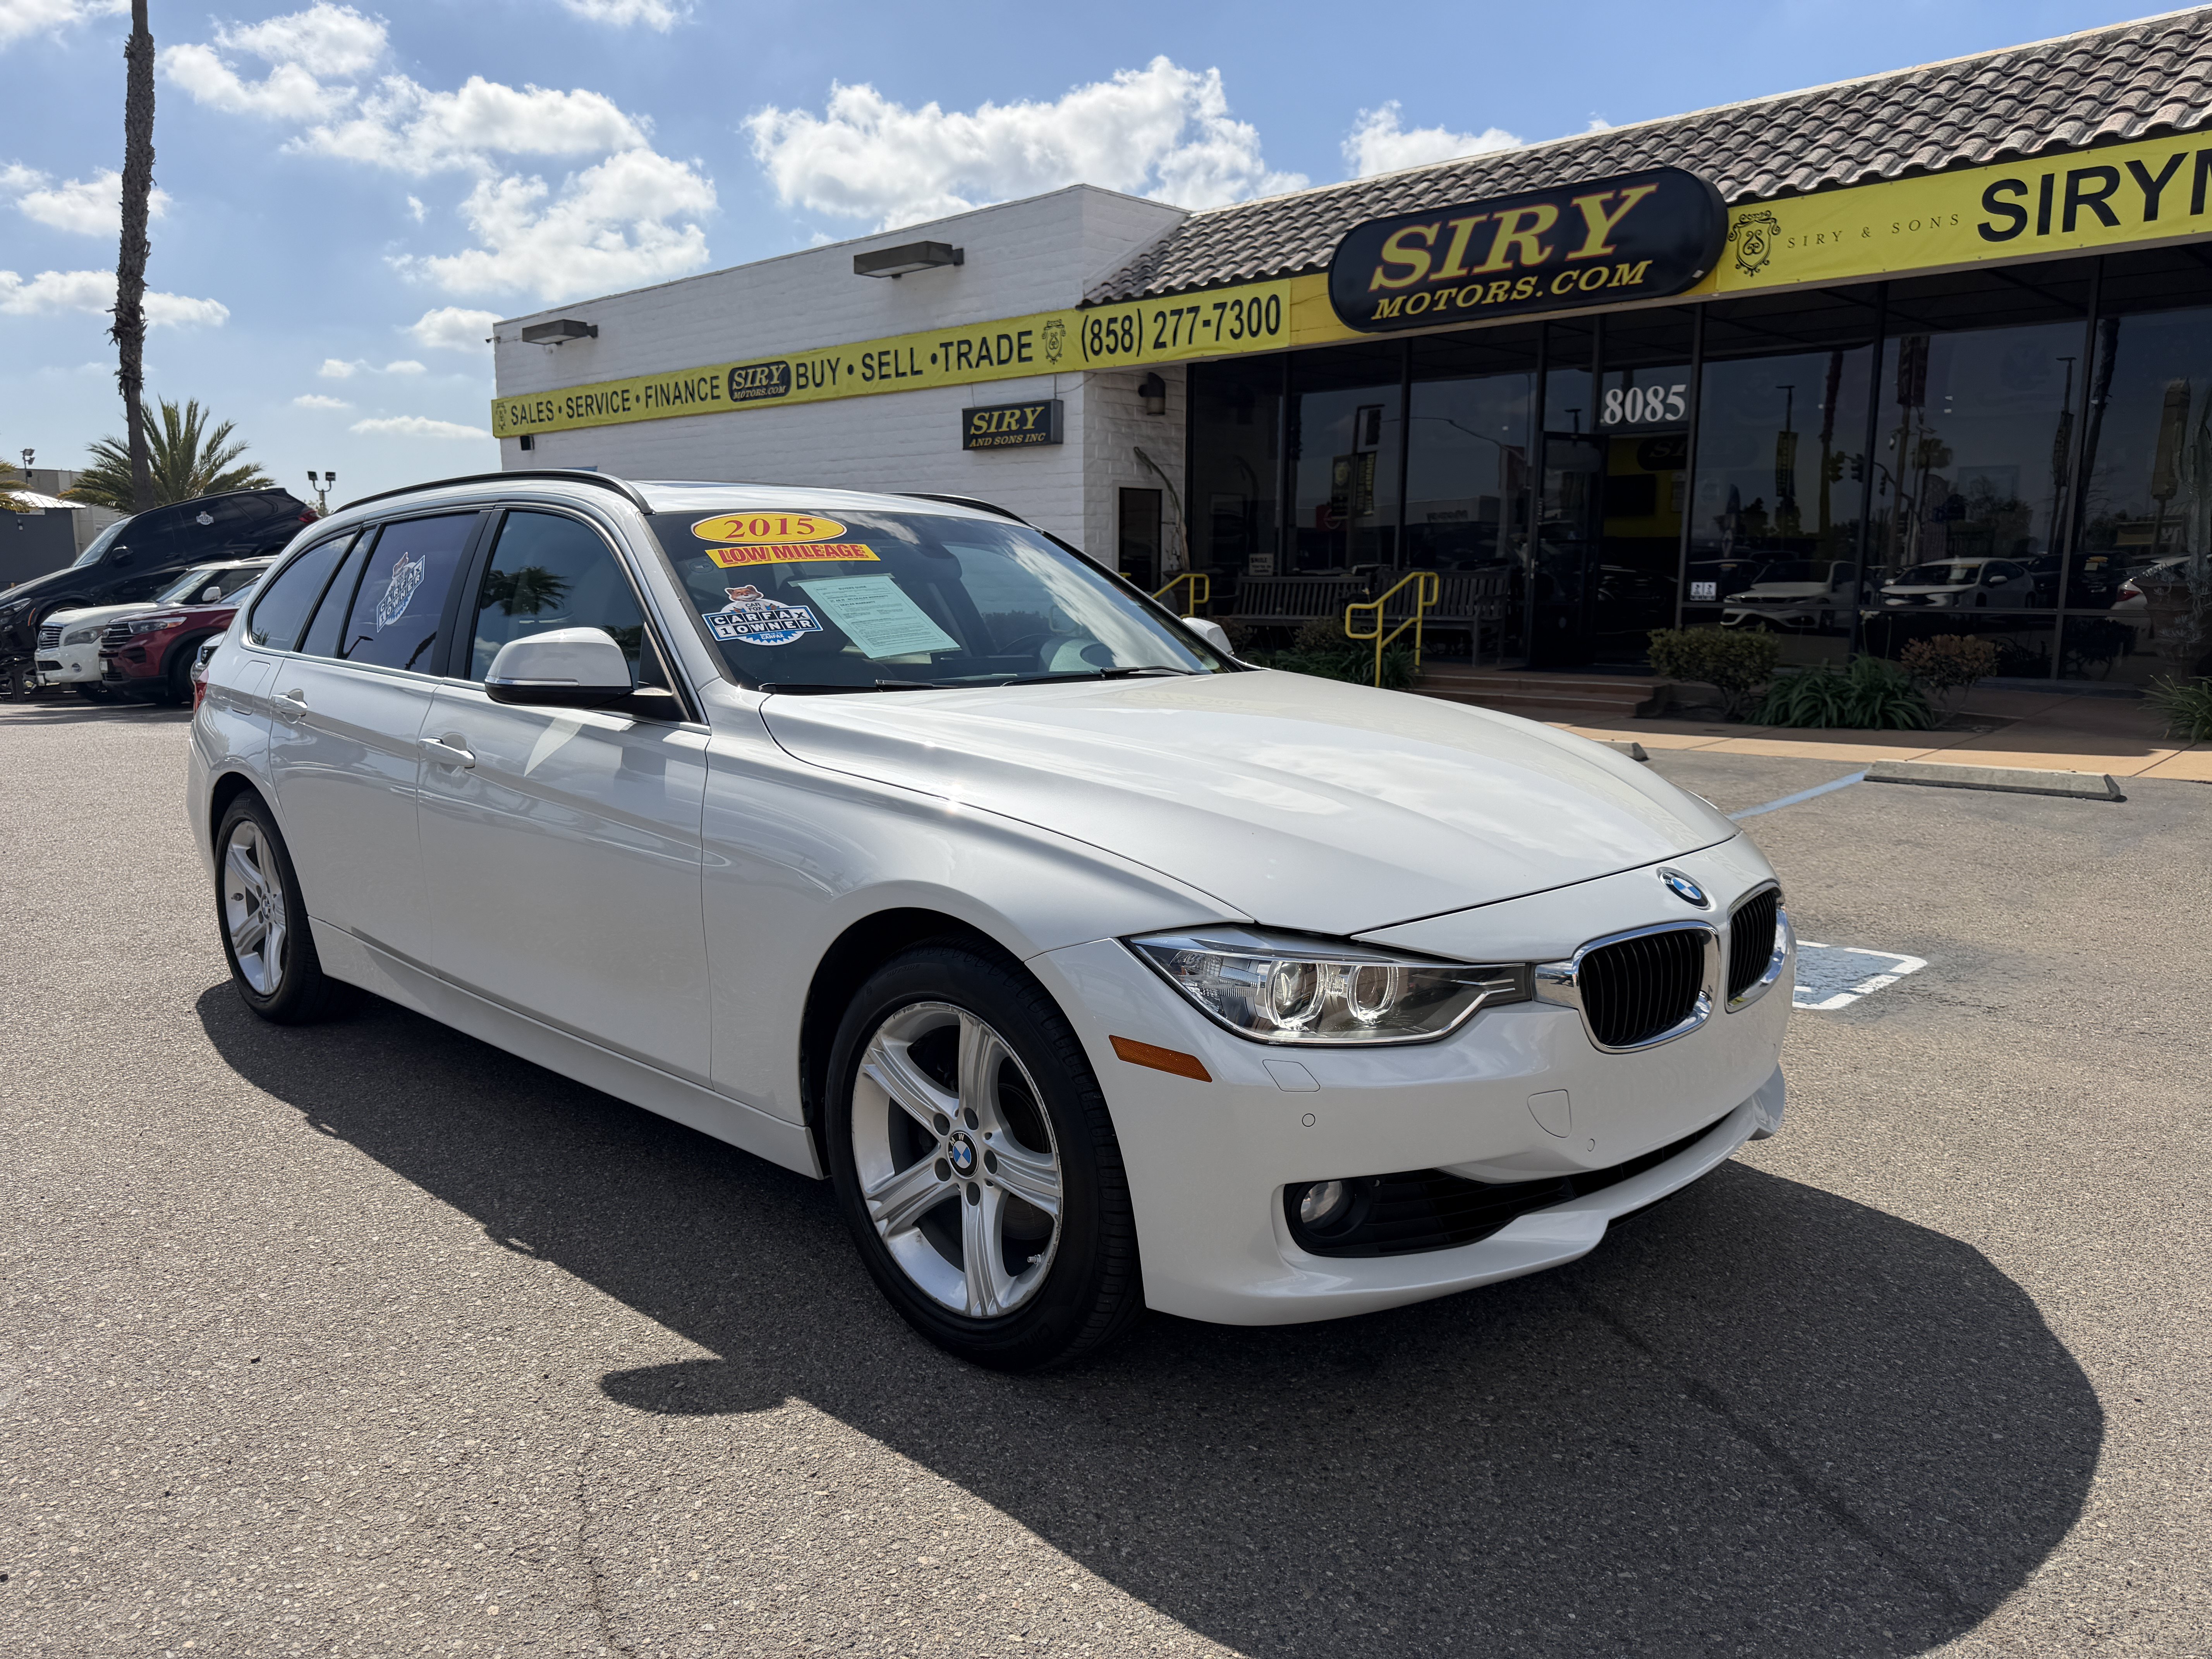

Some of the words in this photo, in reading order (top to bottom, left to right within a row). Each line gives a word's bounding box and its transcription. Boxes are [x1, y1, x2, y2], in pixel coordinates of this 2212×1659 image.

[1368, 183, 1659, 292] SIRY
[1787, 230, 1843, 248] SIRY
[1861, 226, 1871, 238] &
[1891, 214, 1959, 234] SONS
[1371, 260, 1652, 320] MOTORS.COM
[1082, 308, 1143, 362] (858)
[1153, 294, 1281, 350] 277-7300
[796, 357, 841, 390] BUY
[862, 347, 923, 382] SELL
[939, 330, 1033, 372] TRADE
[733, 364, 787, 390] SIRY
[511, 400, 554, 425] SALES
[566, 390, 631, 419] SERVICE
[646, 376, 721, 409] FINANCE
[733, 386, 786, 399] MOTORS.COM
[1604, 384, 1686, 424] 8085
[970, 407, 1045, 434] SIRY
[969, 437, 992, 447] AND
[993, 434, 1024, 445] SONS
[1025, 433, 1046, 443] INC
[724, 518, 815, 539] 2015
[718, 547, 767, 564] LOW
[771, 544, 867, 560] MILEAGE
[380, 565, 421, 612] CARFAX
[386, 574, 420, 615] OWNER
[714, 611, 805, 625] CARFAX
[736, 620, 812, 633] OWNER
[949, 1133, 964, 1158] BMW
